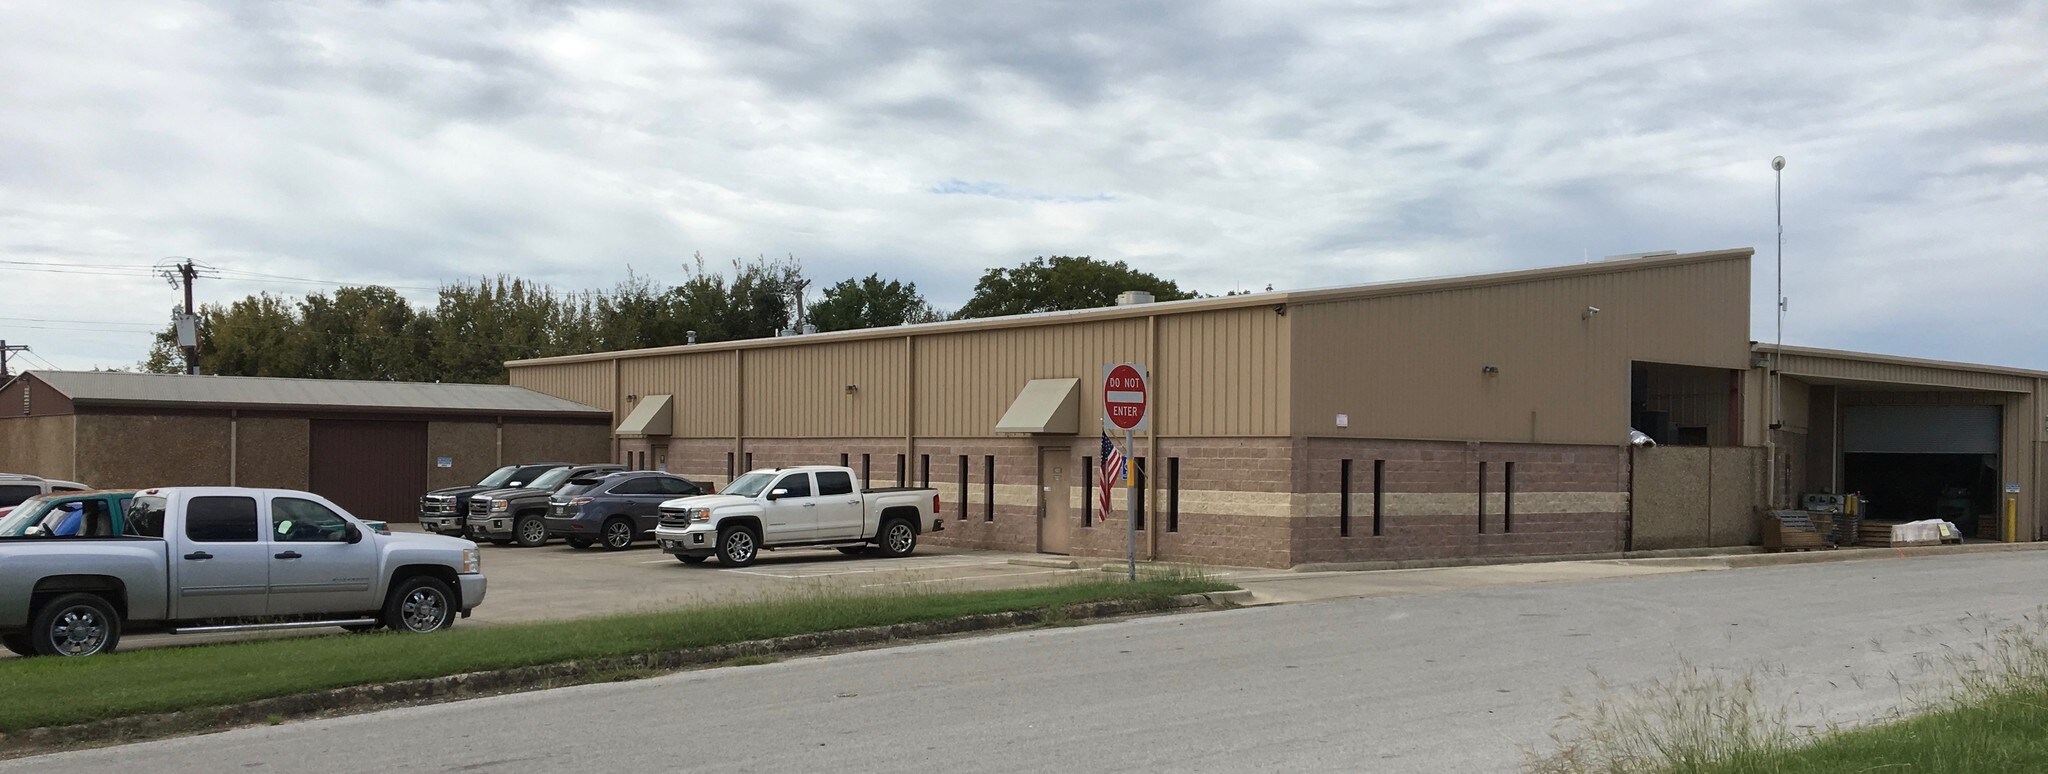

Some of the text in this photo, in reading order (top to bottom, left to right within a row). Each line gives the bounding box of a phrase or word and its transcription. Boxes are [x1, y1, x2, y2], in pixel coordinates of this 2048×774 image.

[1110, 378, 1139, 388] DO NOT
[1113, 406, 1137, 416] ENTER
